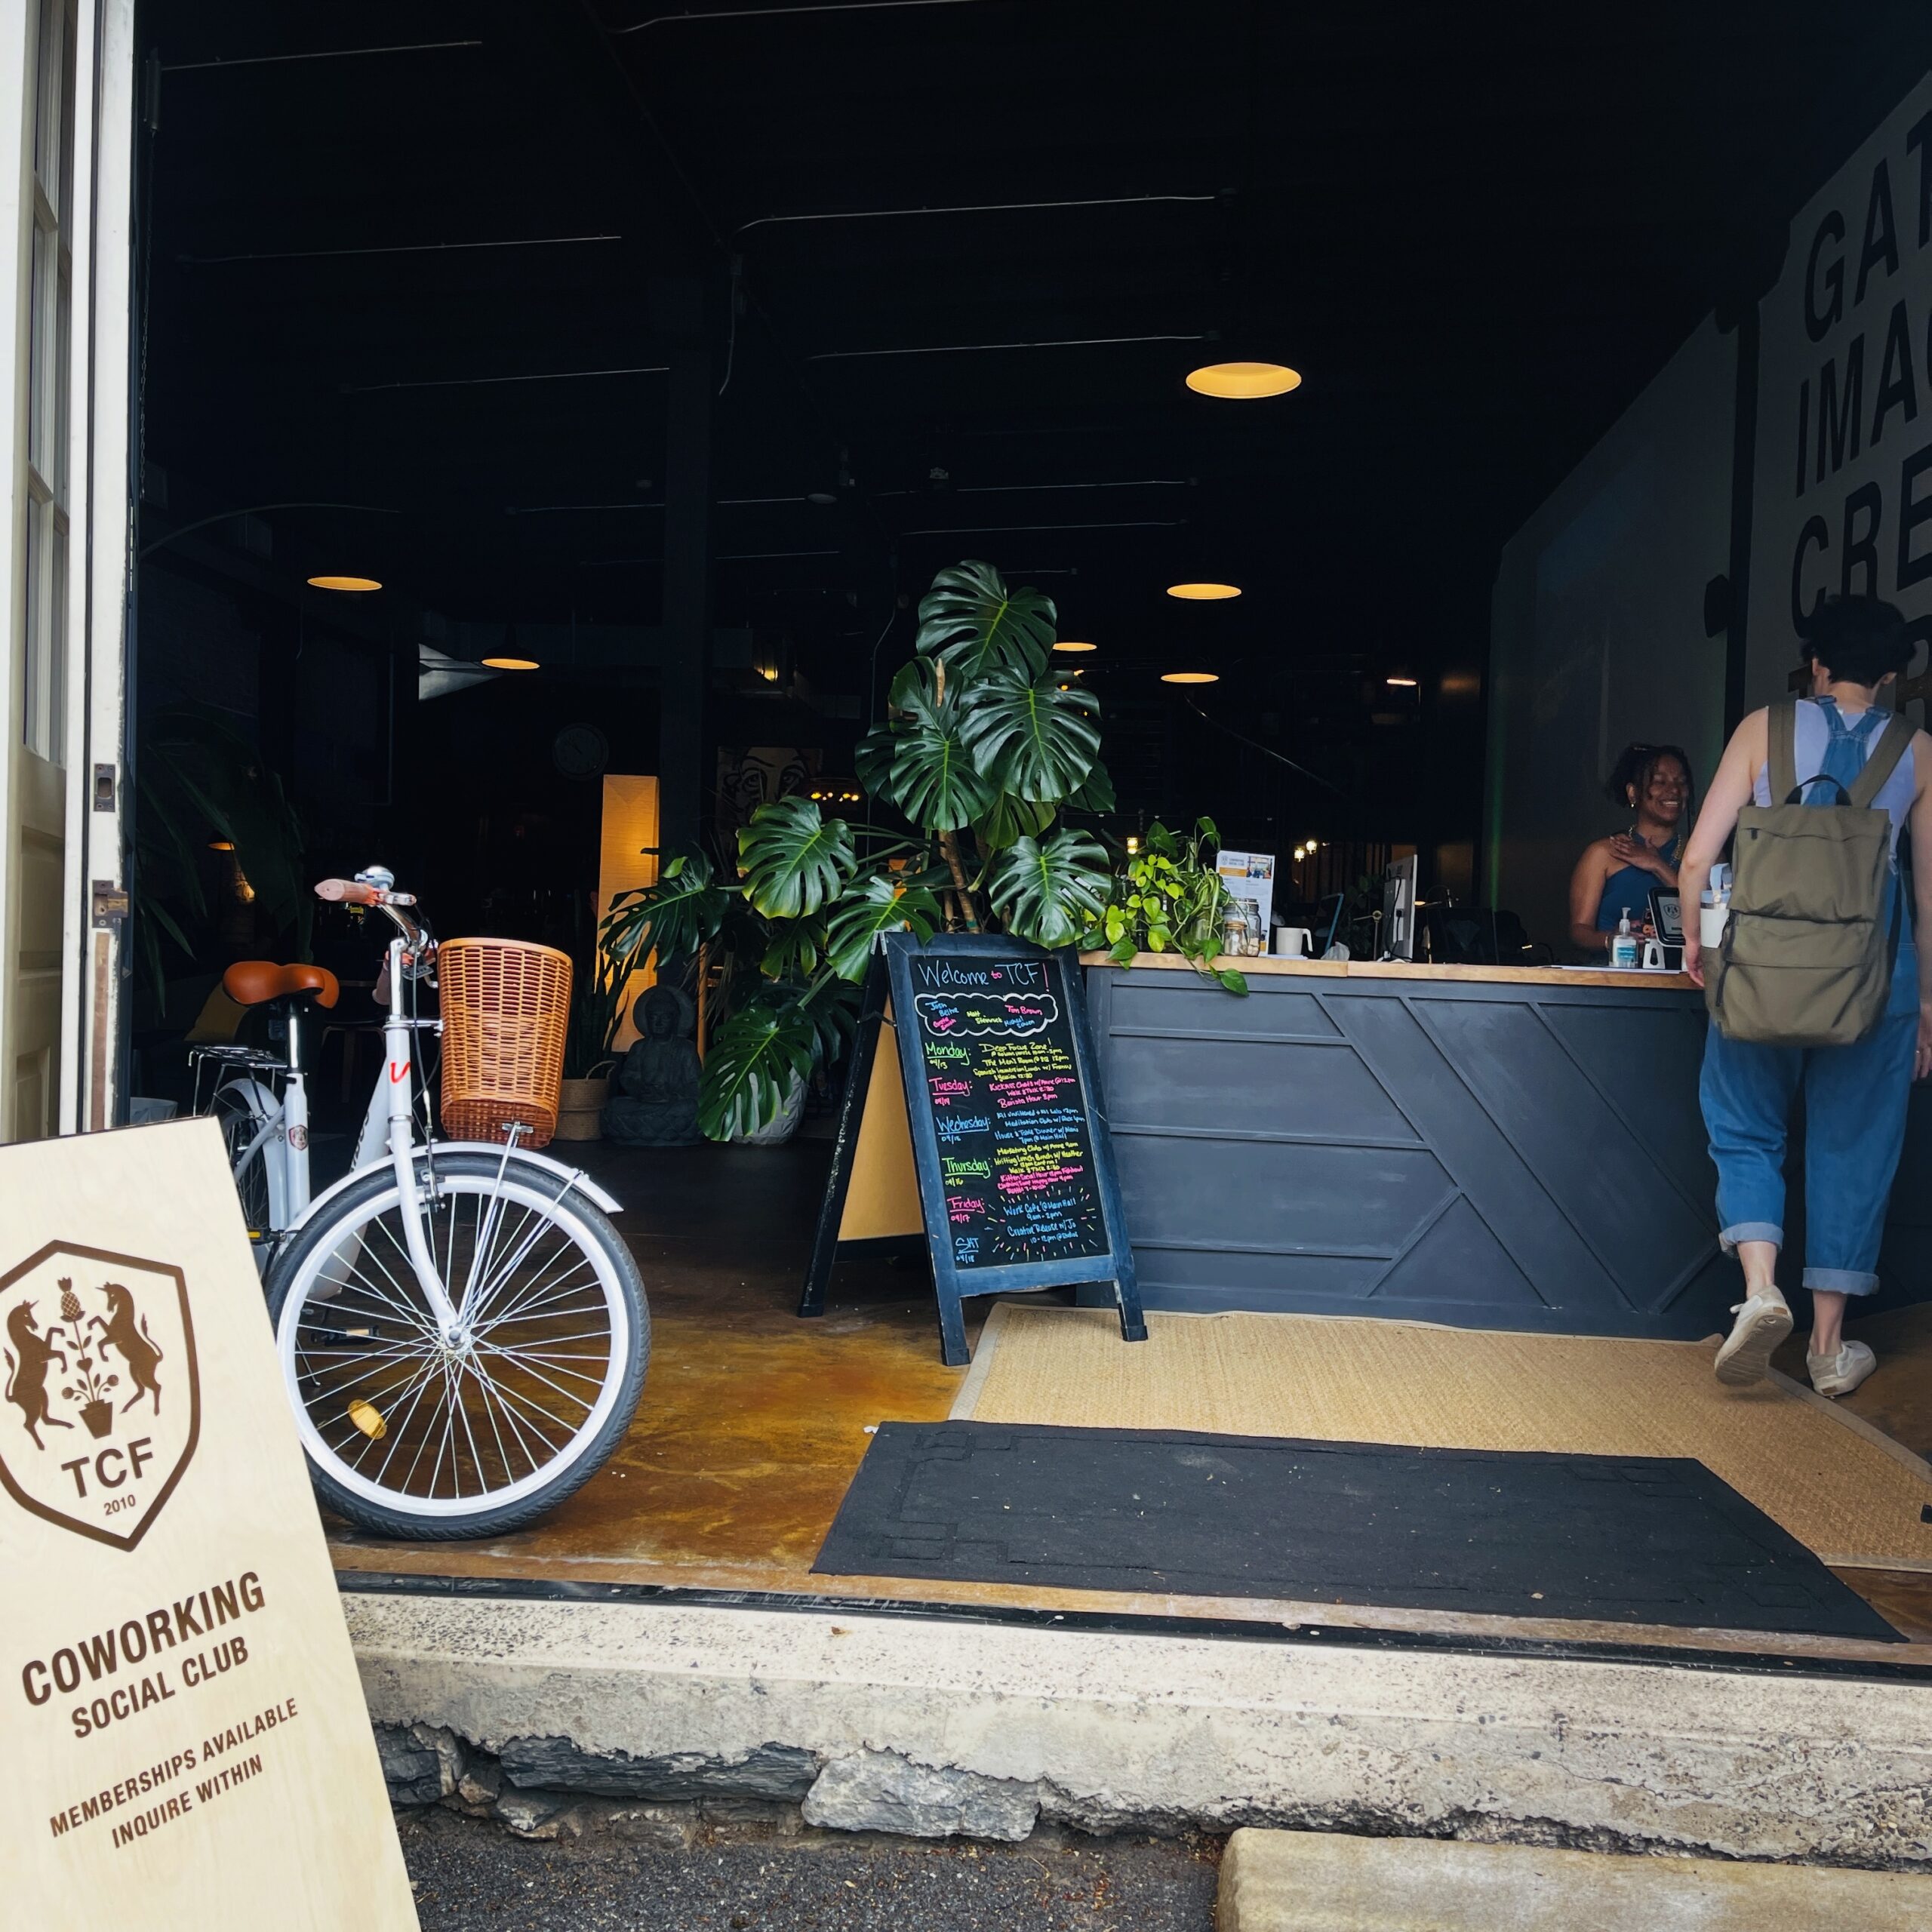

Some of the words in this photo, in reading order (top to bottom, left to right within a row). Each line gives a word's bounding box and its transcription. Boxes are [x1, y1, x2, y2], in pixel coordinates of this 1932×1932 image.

[1795, 297, 1932, 498] IMA
[918, 960, 989, 987] Welcome
[924, 1041, 971, 1066] Monday:
[928, 1077, 973, 1097] Tuesday:
[936, 1115, 991, 1133] Wednesday:
[946, 1196, 986, 1214] Friday:
[1062, 1197, 1076, 1208] Hall
[61, 1437, 154, 1498] TCF
[103, 1494, 137, 1518] 2010
[21, 1571, 266, 1707] COWORKING
[71, 1678, 175, 1739] SOCIAL
[182, 1635, 250, 1690] CLUB
[49, 1749, 197, 1838] MEMBERSHIPS
[202, 1698, 299, 1761] AVAILABLE
[111, 1793, 193, 1849] INQUIRE
[195, 1753, 264, 1807] WITHIN
